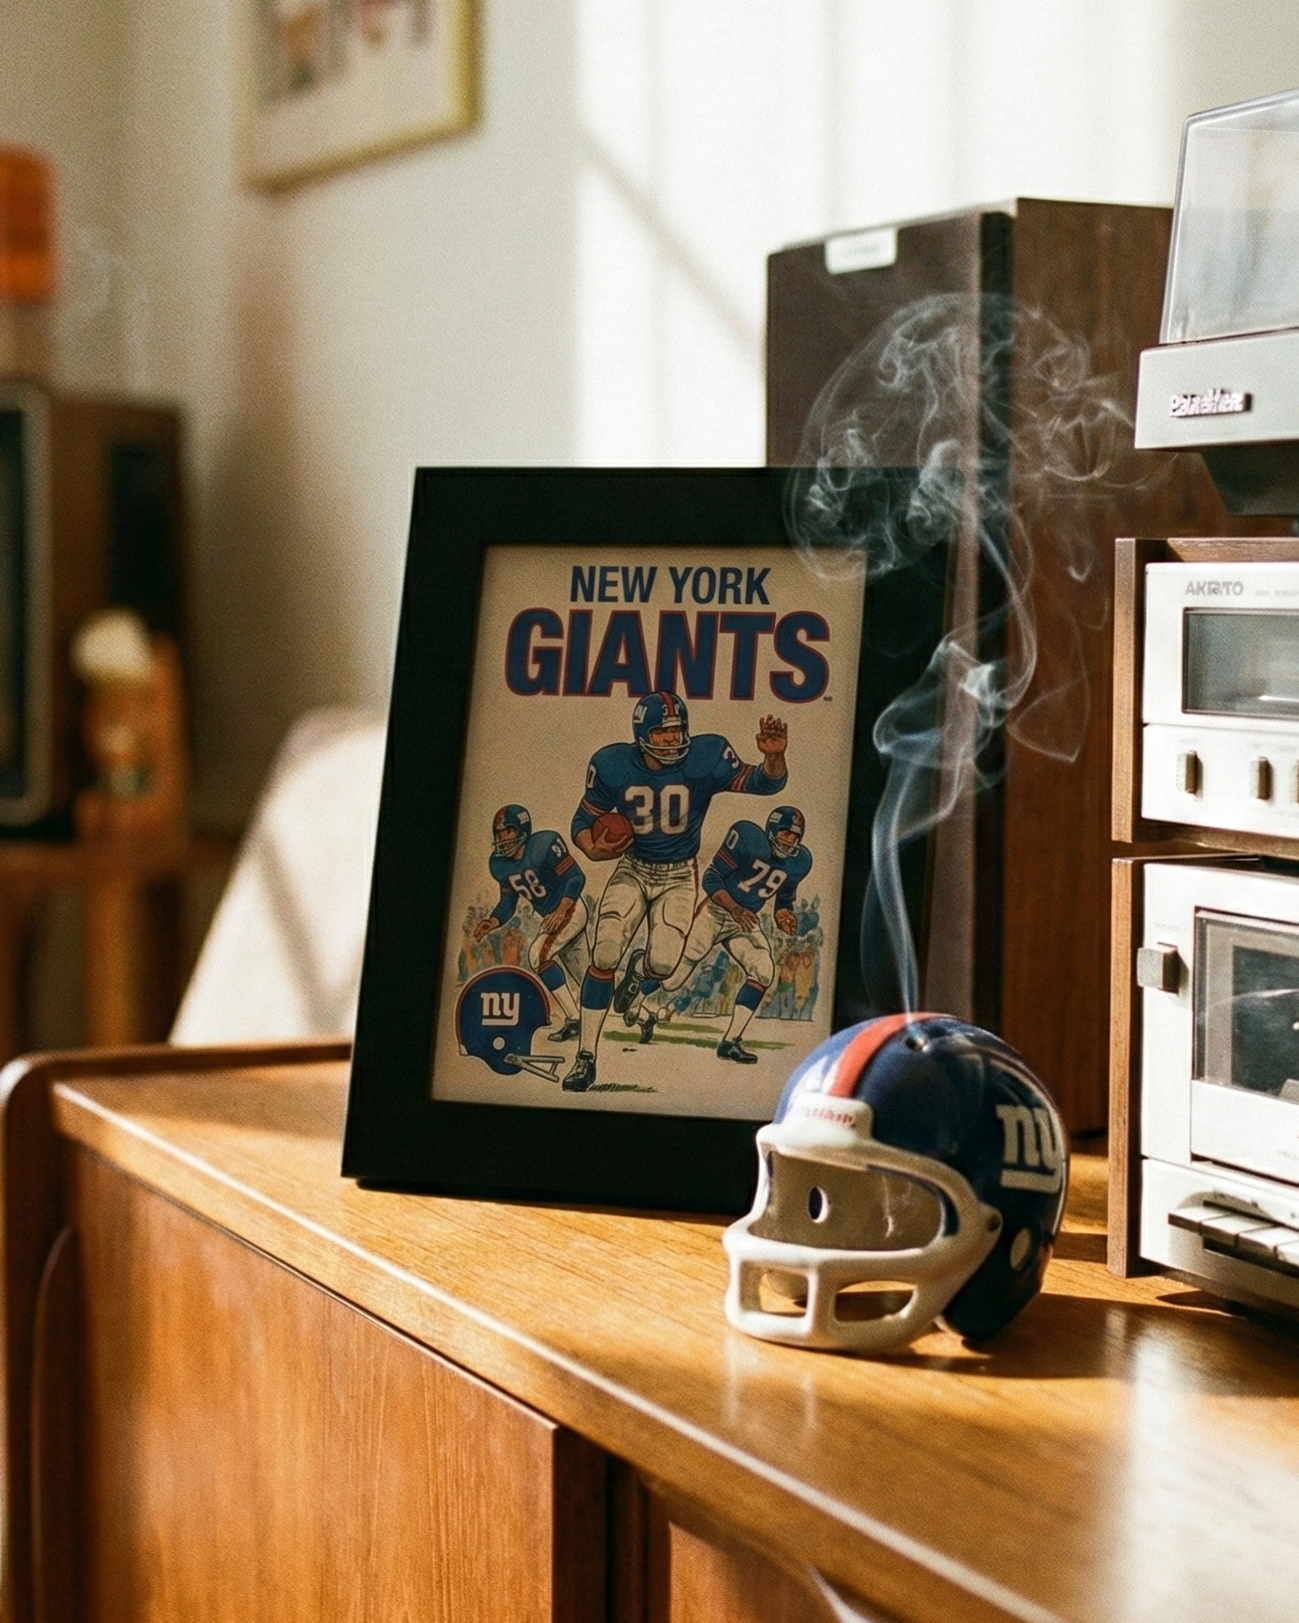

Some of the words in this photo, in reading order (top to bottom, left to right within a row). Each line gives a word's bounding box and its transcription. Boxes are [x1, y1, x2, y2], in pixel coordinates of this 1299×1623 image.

[570, 566, 657, 603] NEW
[669, 566, 771, 605] YORK
[505, 607, 830, 703] GIANTS
[624, 784, 690, 835] 30
[508, 868, 547, 900] 58
[737, 858, 787, 899] 79
